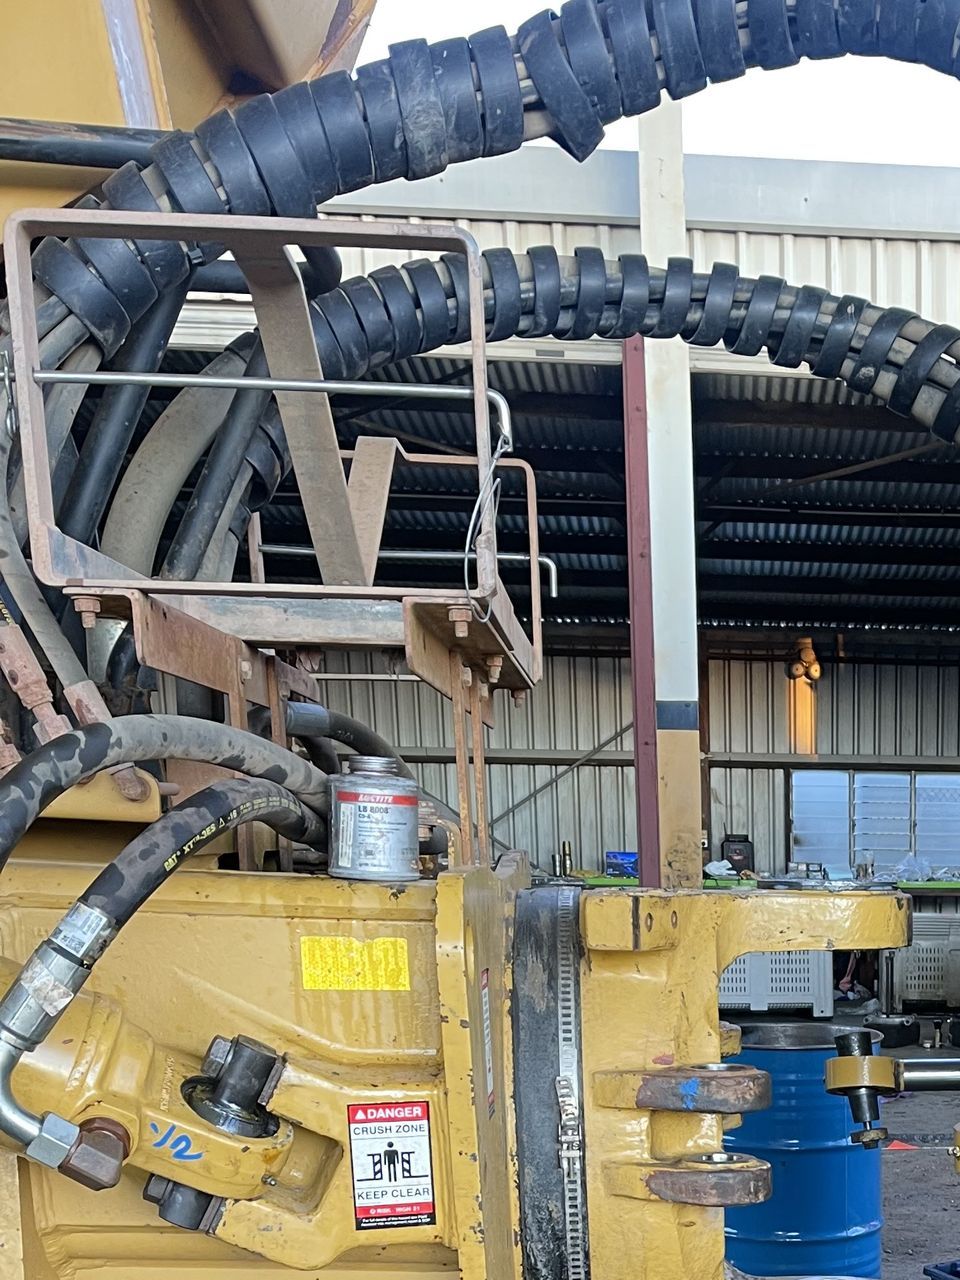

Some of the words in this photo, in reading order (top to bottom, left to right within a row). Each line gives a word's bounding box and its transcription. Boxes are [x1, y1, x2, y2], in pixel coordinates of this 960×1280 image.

[366, 1106, 422, 1120] DANGER
[353, 1125, 392, 1136] CRUSH
[395, 1123, 426, 1134] ZONE
[357, 1190, 388, 1201] KEEP
[391, 1187, 430, 1198] CLEAR
